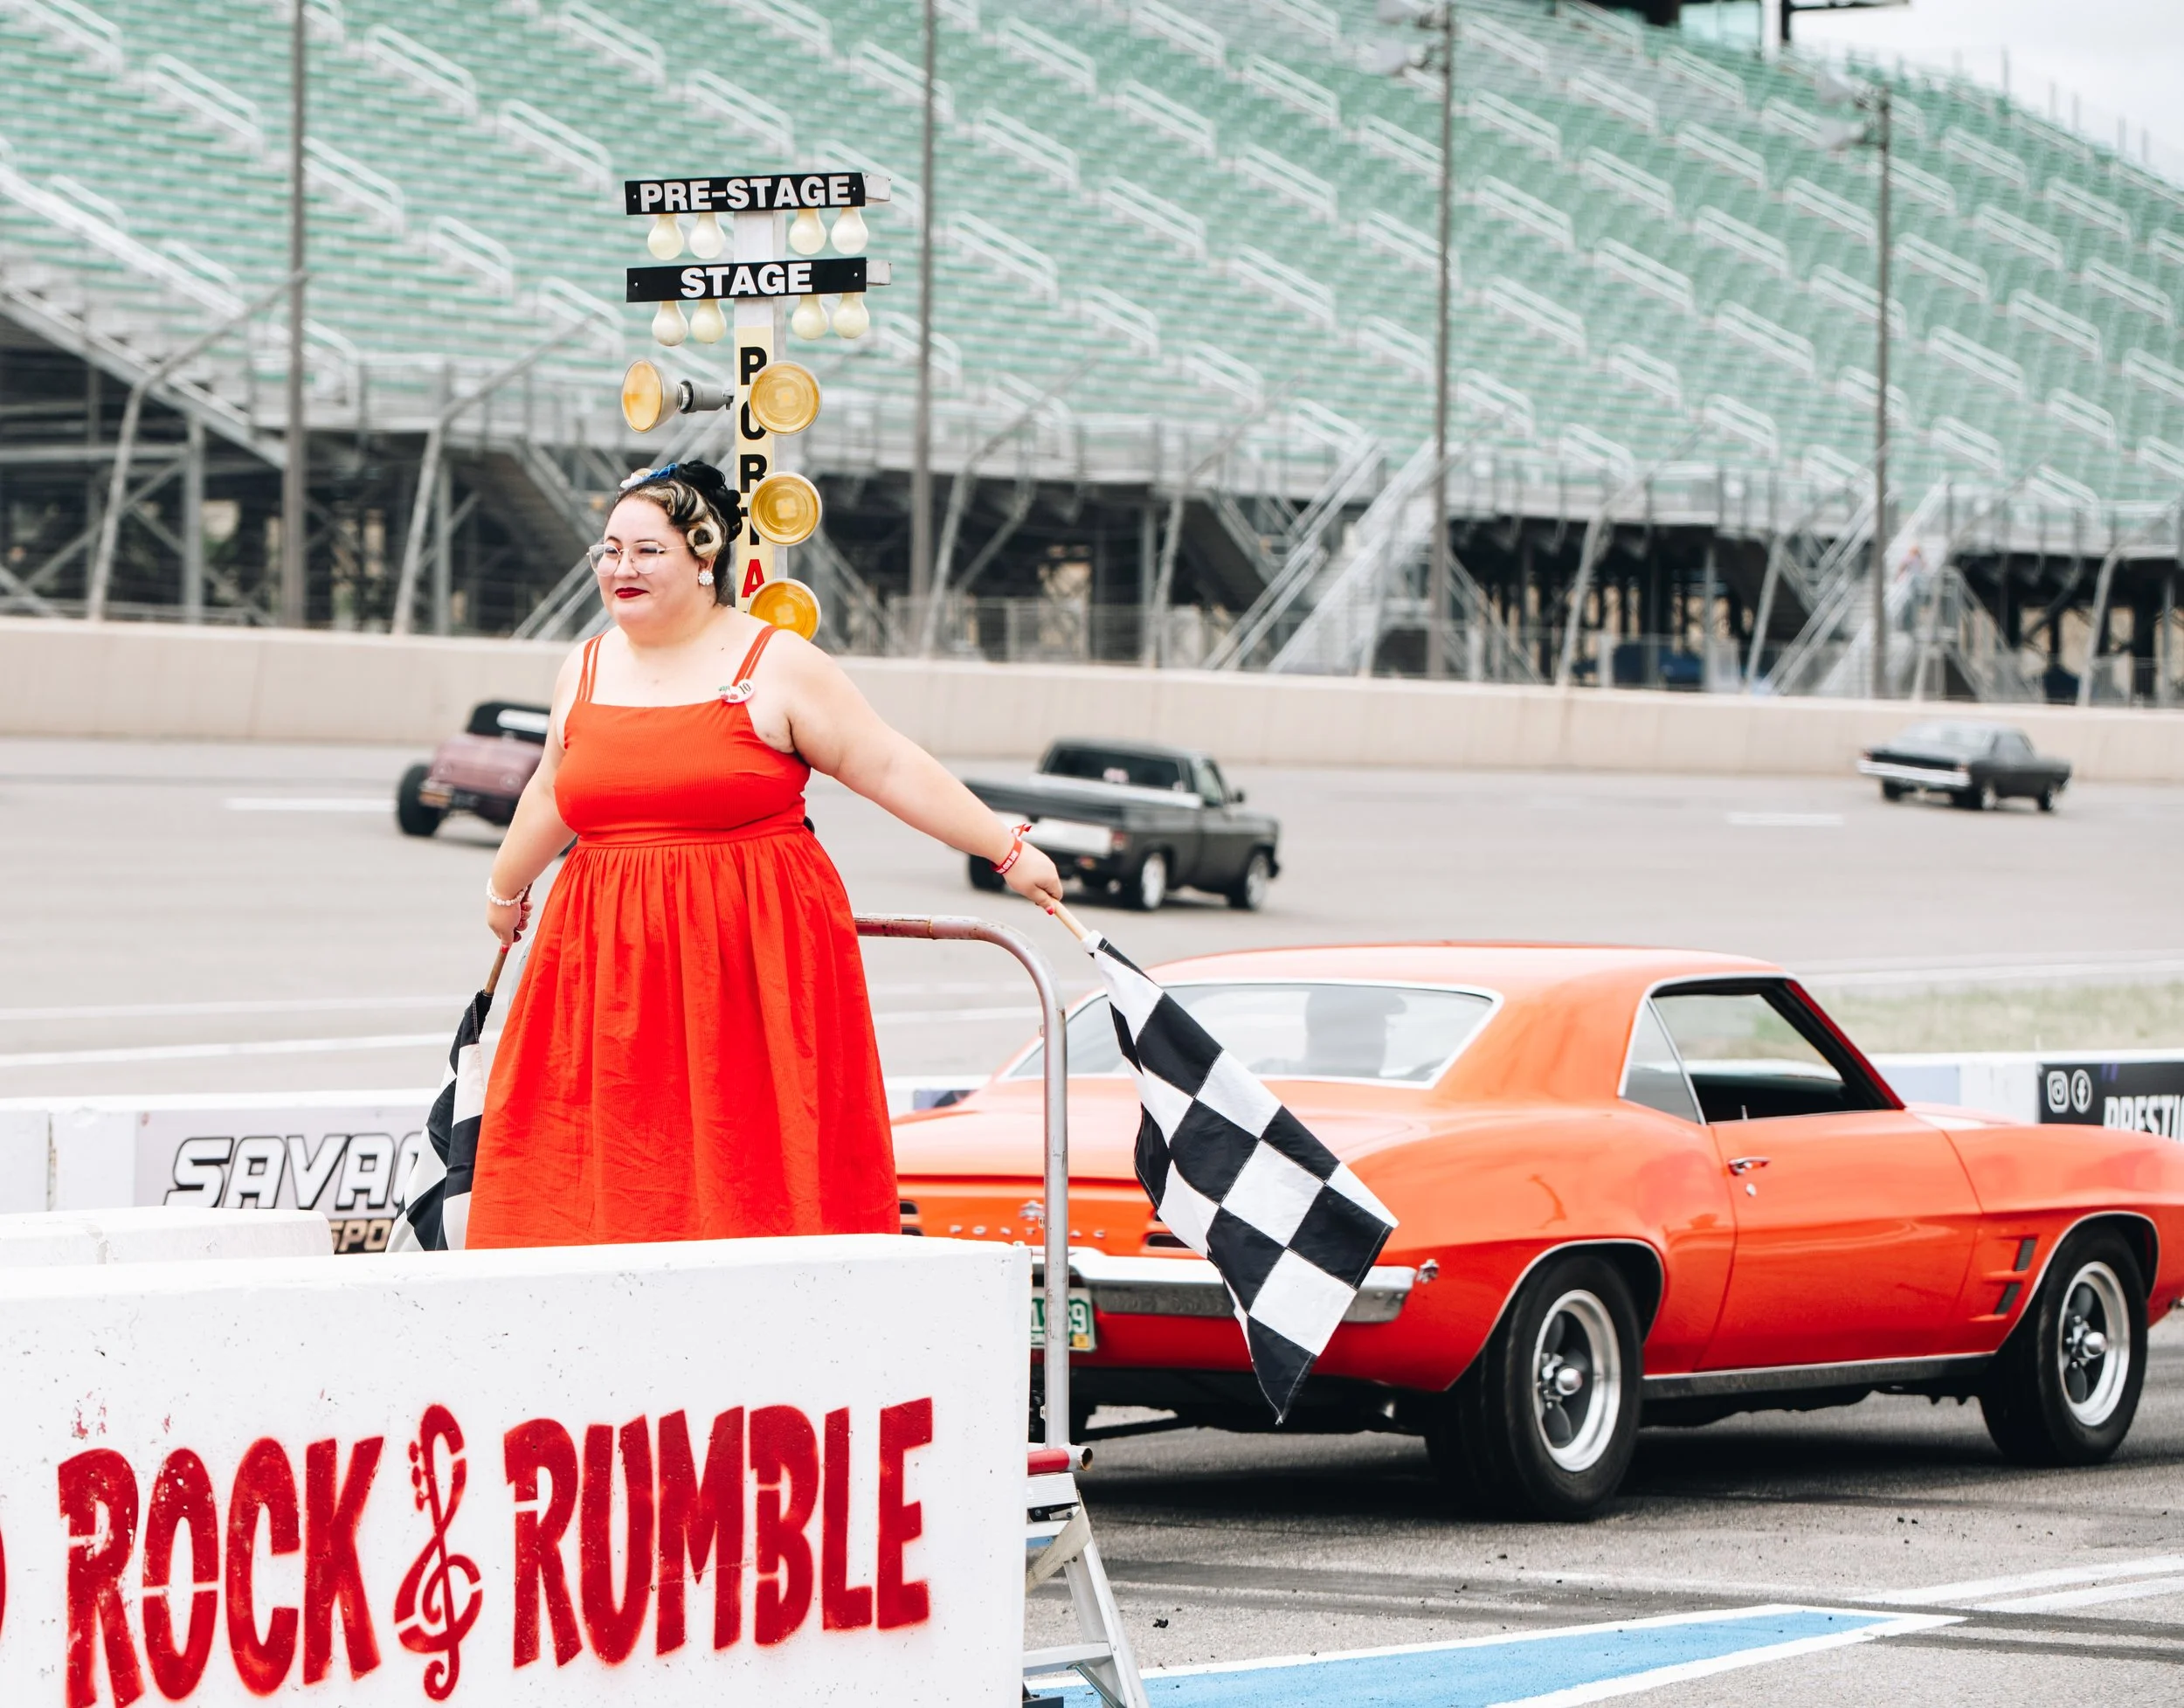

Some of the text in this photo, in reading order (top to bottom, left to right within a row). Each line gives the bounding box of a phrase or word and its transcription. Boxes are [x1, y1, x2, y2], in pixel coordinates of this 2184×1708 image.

[639, 176, 851, 212] PRE-STAGE
[681, 262, 812, 298] STAGE
[740, 346, 769, 613] PORTA
[739, 682, 752, 695] 10
[2104, 1094, 2184, 1143] PRESTI
[949, 1224, 1106, 1240] PONTAC
[58, 1435, 384, 1708] ROCK
[503, 1396, 933, 1670] RUMBLE
